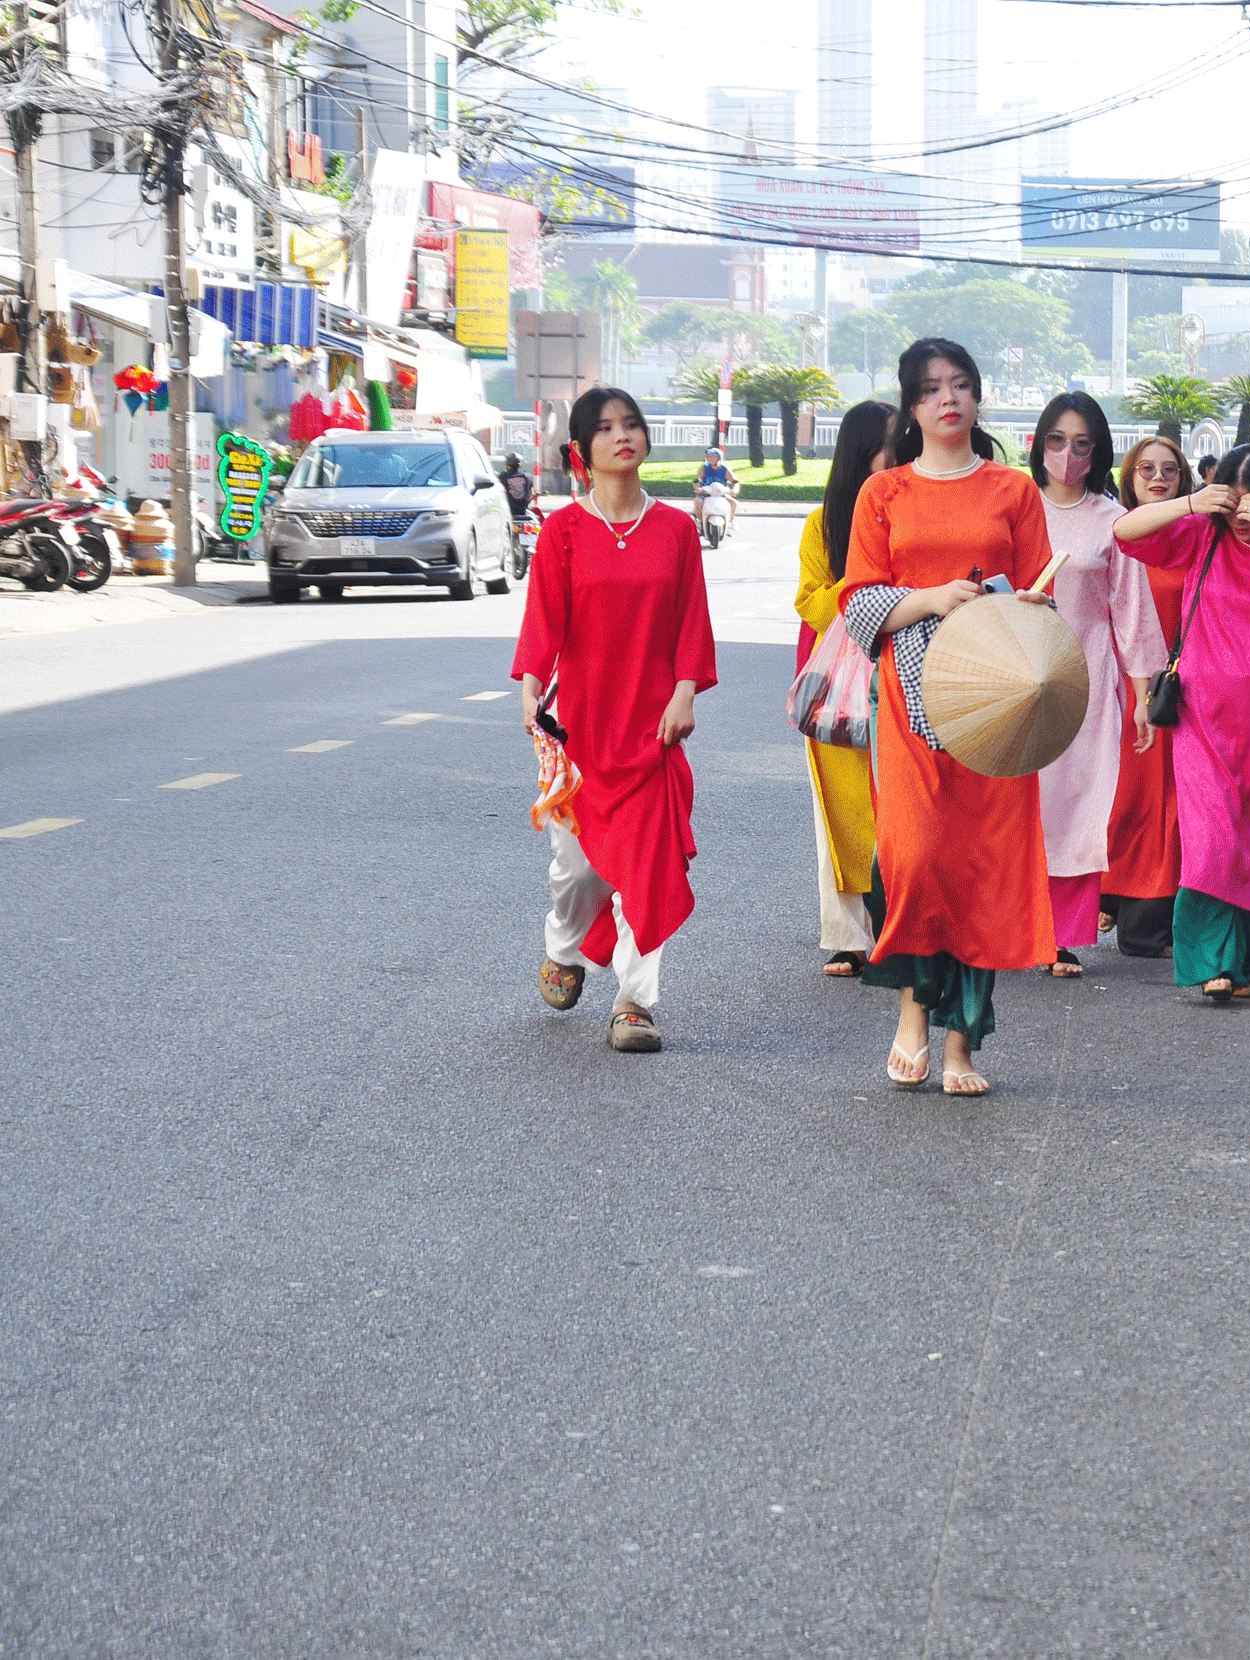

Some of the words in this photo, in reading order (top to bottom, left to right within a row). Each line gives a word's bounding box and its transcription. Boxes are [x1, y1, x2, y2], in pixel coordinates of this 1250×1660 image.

[1051, 211, 1100, 230] 0913
[1105, 211, 1144, 231] 497
[1150, 211, 1189, 231] 695
